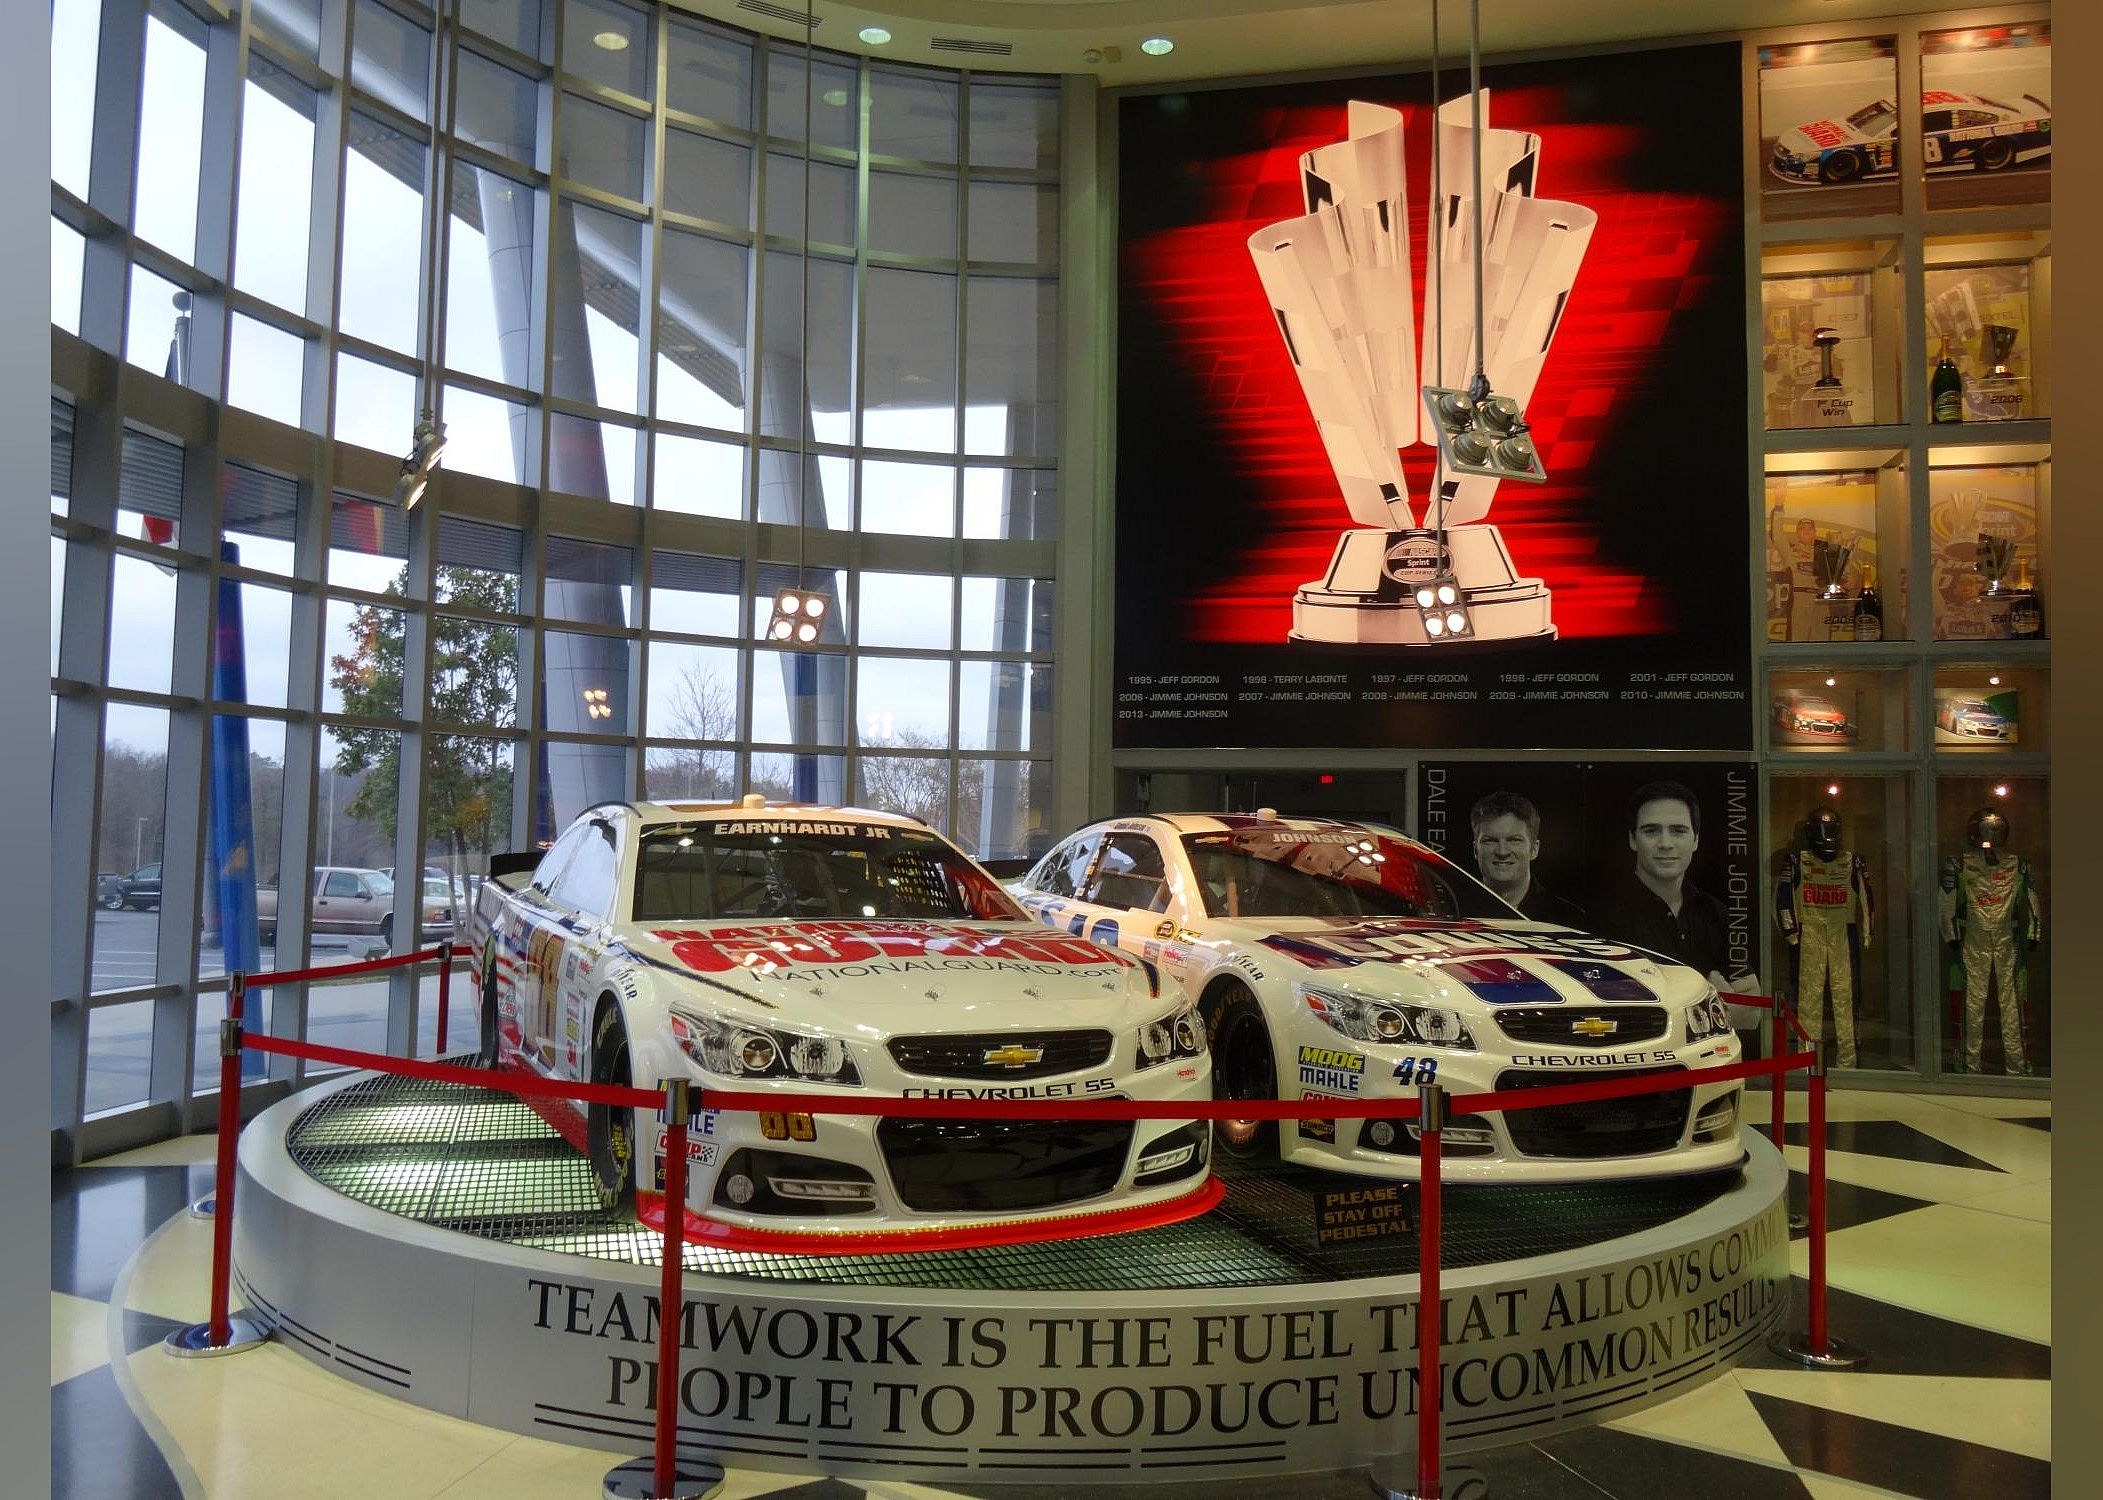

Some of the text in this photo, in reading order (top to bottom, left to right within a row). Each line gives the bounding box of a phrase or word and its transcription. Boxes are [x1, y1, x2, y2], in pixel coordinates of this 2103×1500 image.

[1822, 408, 1845, 417] Win
[1407, 558, 1430, 567] Sprint
[1128, 675, 1220, 684] 1995 JEFF GORDON
[1274, 675, 1302, 684] TERRY
[1305, 675, 1348, 684] LABONTE
[1371, 674, 1468, 683] 1997 JEFF GORDON
[1531, 673, 1554, 682] JEFF
[1556, 673, 1599, 682] GORDON
[1630, 673, 1734, 682] 2001 JEFF GORDON
[1119, 692, 1228, 701] 2006 JIMMIE JOHNSON
[1238, 692, 1351, 701] 2007 JIMMIE JOHNSON
[1362, 691, 1477, 700] 2008 JIMMIE JOHNSON
[1489, 691, 1609, 700] 2009 JIMMIE JOHNSON
[1620, 691, 1744, 700] 2010 JIMMIE JOHNSON
[1119, 710, 1228, 718] 2013 JIMMIE JOHNSON
[1427, 769, 1446, 823] DALE
[714, 822, 891, 839] EARNHARDT JR
[1272, 832, 1356, 845] JOHNSON
[1727, 771, 1748, 982] JIMMIE JOHNSON
[671, 933, 1136, 973] GUARD
[1300, 1046, 1364, 1070] MOOG
[1511, 1052, 1648, 1066] CHEVROLET
[1393, 1056, 1438, 1086] 48
[1300, 1067, 1359, 1092] MAHLE
[902, 1082, 1076, 1100] CHEVROLET
[1325, 1187, 1398, 1207] PLEASE
[1324, 1204, 1402, 1224] STAY OFF
[1318, 1219, 1412, 1242] PEDESTAL
[528, 1278, 922, 1368] TEAMWORK
[943, 1316, 1007, 1369] IS
[1029, 1317, 1172, 1369] THE
[1192, 1308, 1353, 1366] FUEL
[1370, 1287, 1528, 1354] THAT
[1541, 1250, 1701, 1331] ALLOWS
[873, 1382, 975, 1436] TO
[997, 1375, 1339, 1438] PRODUCE
[1357, 1315, 1675, 1420] UNCOMMON
[1682, 1274, 1776, 1354] RESULTS
